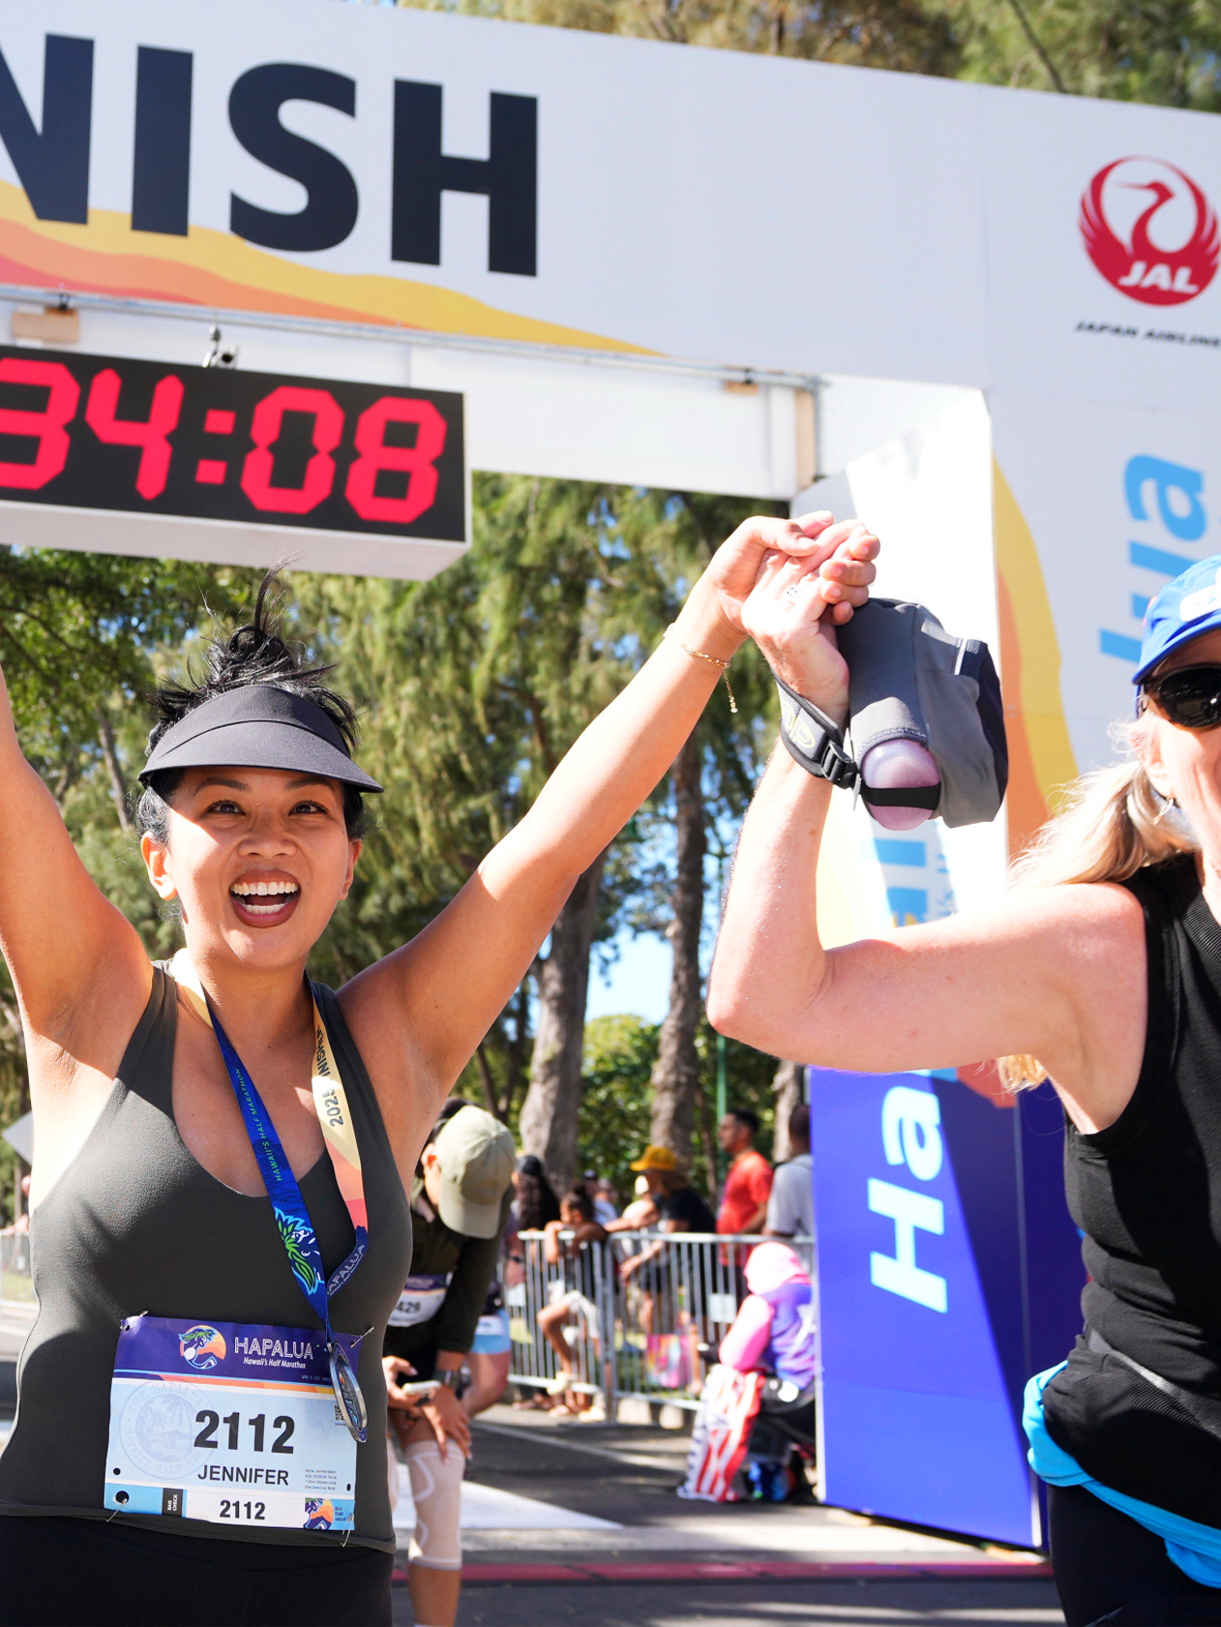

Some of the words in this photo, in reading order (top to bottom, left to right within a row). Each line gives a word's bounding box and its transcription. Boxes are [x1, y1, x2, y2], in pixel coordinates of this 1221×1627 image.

[1117, 260, 1200, 295] JAL
[1074, 320, 1139, 338] JAPAN
[235, 1068, 258, 1116] MARATHON
[253, 1117, 267, 1139] HALF
[262, 1141, 283, 1182] HAWAII'S
[327, 1244, 365, 1295] APALUA
[234, 1336, 314, 1360] HAPALUA
[243, 1357, 268, 1366] Hawaii's
[268, 1359, 281, 1367] Half
[281, 1360, 306, 1369] Marathon
[193, 1409, 295, 1455] 2112
[197, 1464, 289, 1486] JENNIFER
[219, 1499, 266, 1521] 2112
